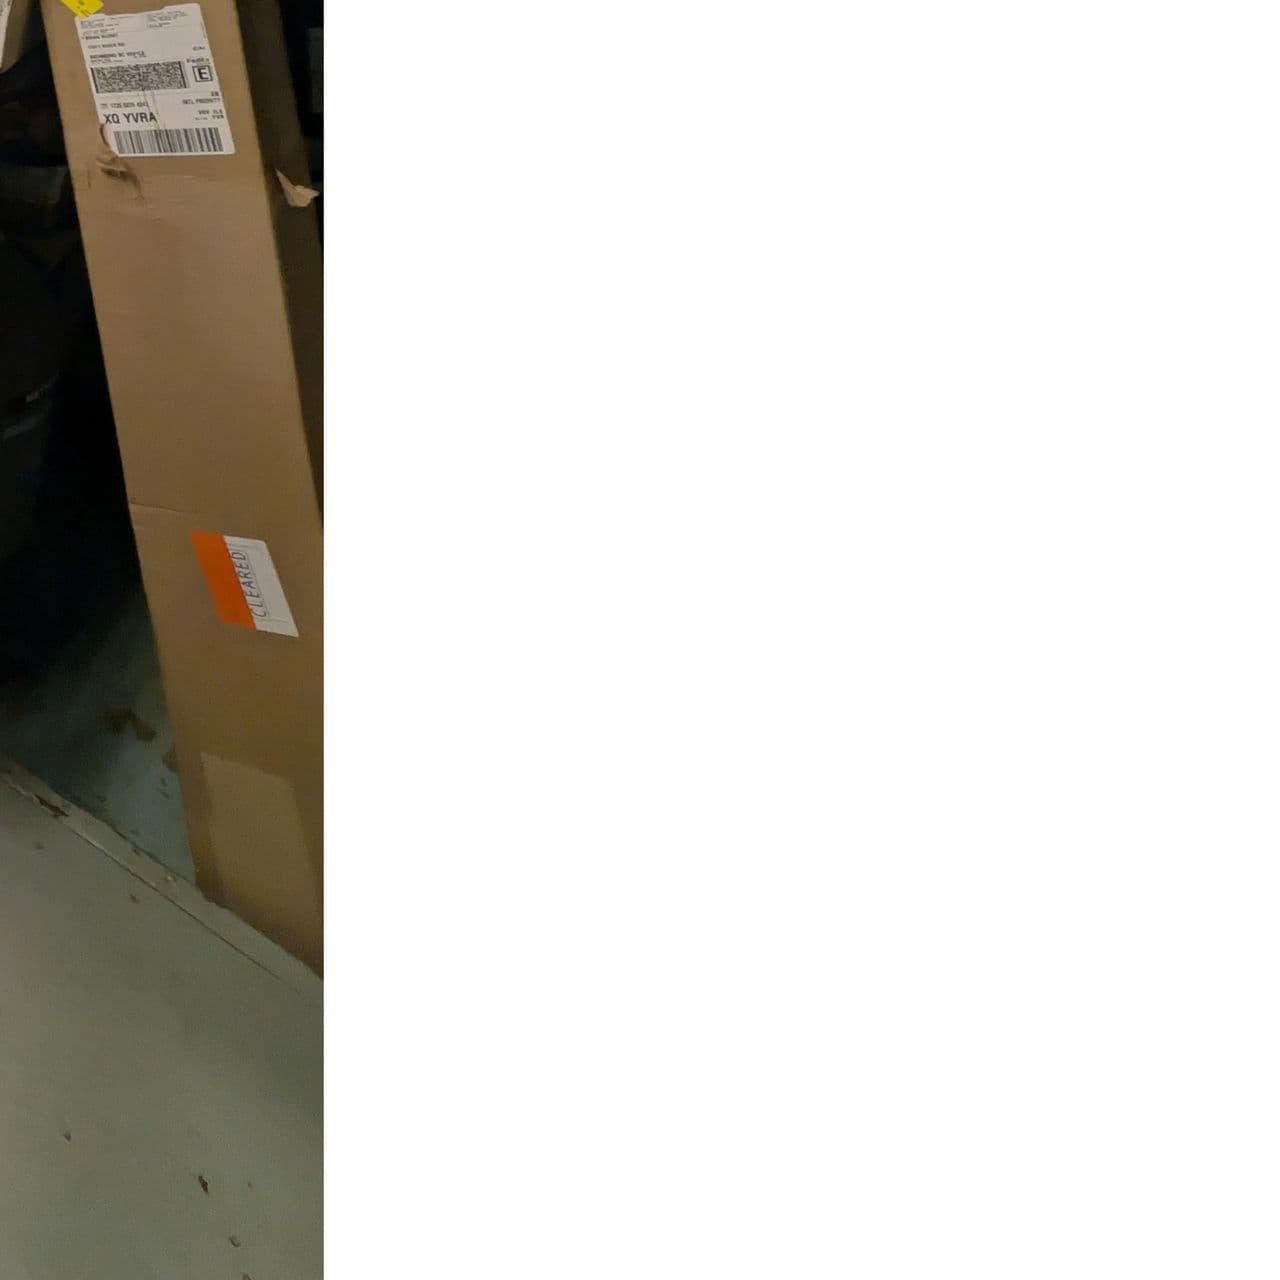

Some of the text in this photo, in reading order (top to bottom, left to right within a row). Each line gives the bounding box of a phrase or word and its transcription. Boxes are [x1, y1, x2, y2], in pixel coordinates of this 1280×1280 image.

[198, 66, 209, 80] E
[104, 111, 158, 124] XQ YVRA
[232, 551, 267, 618] CLEARED
